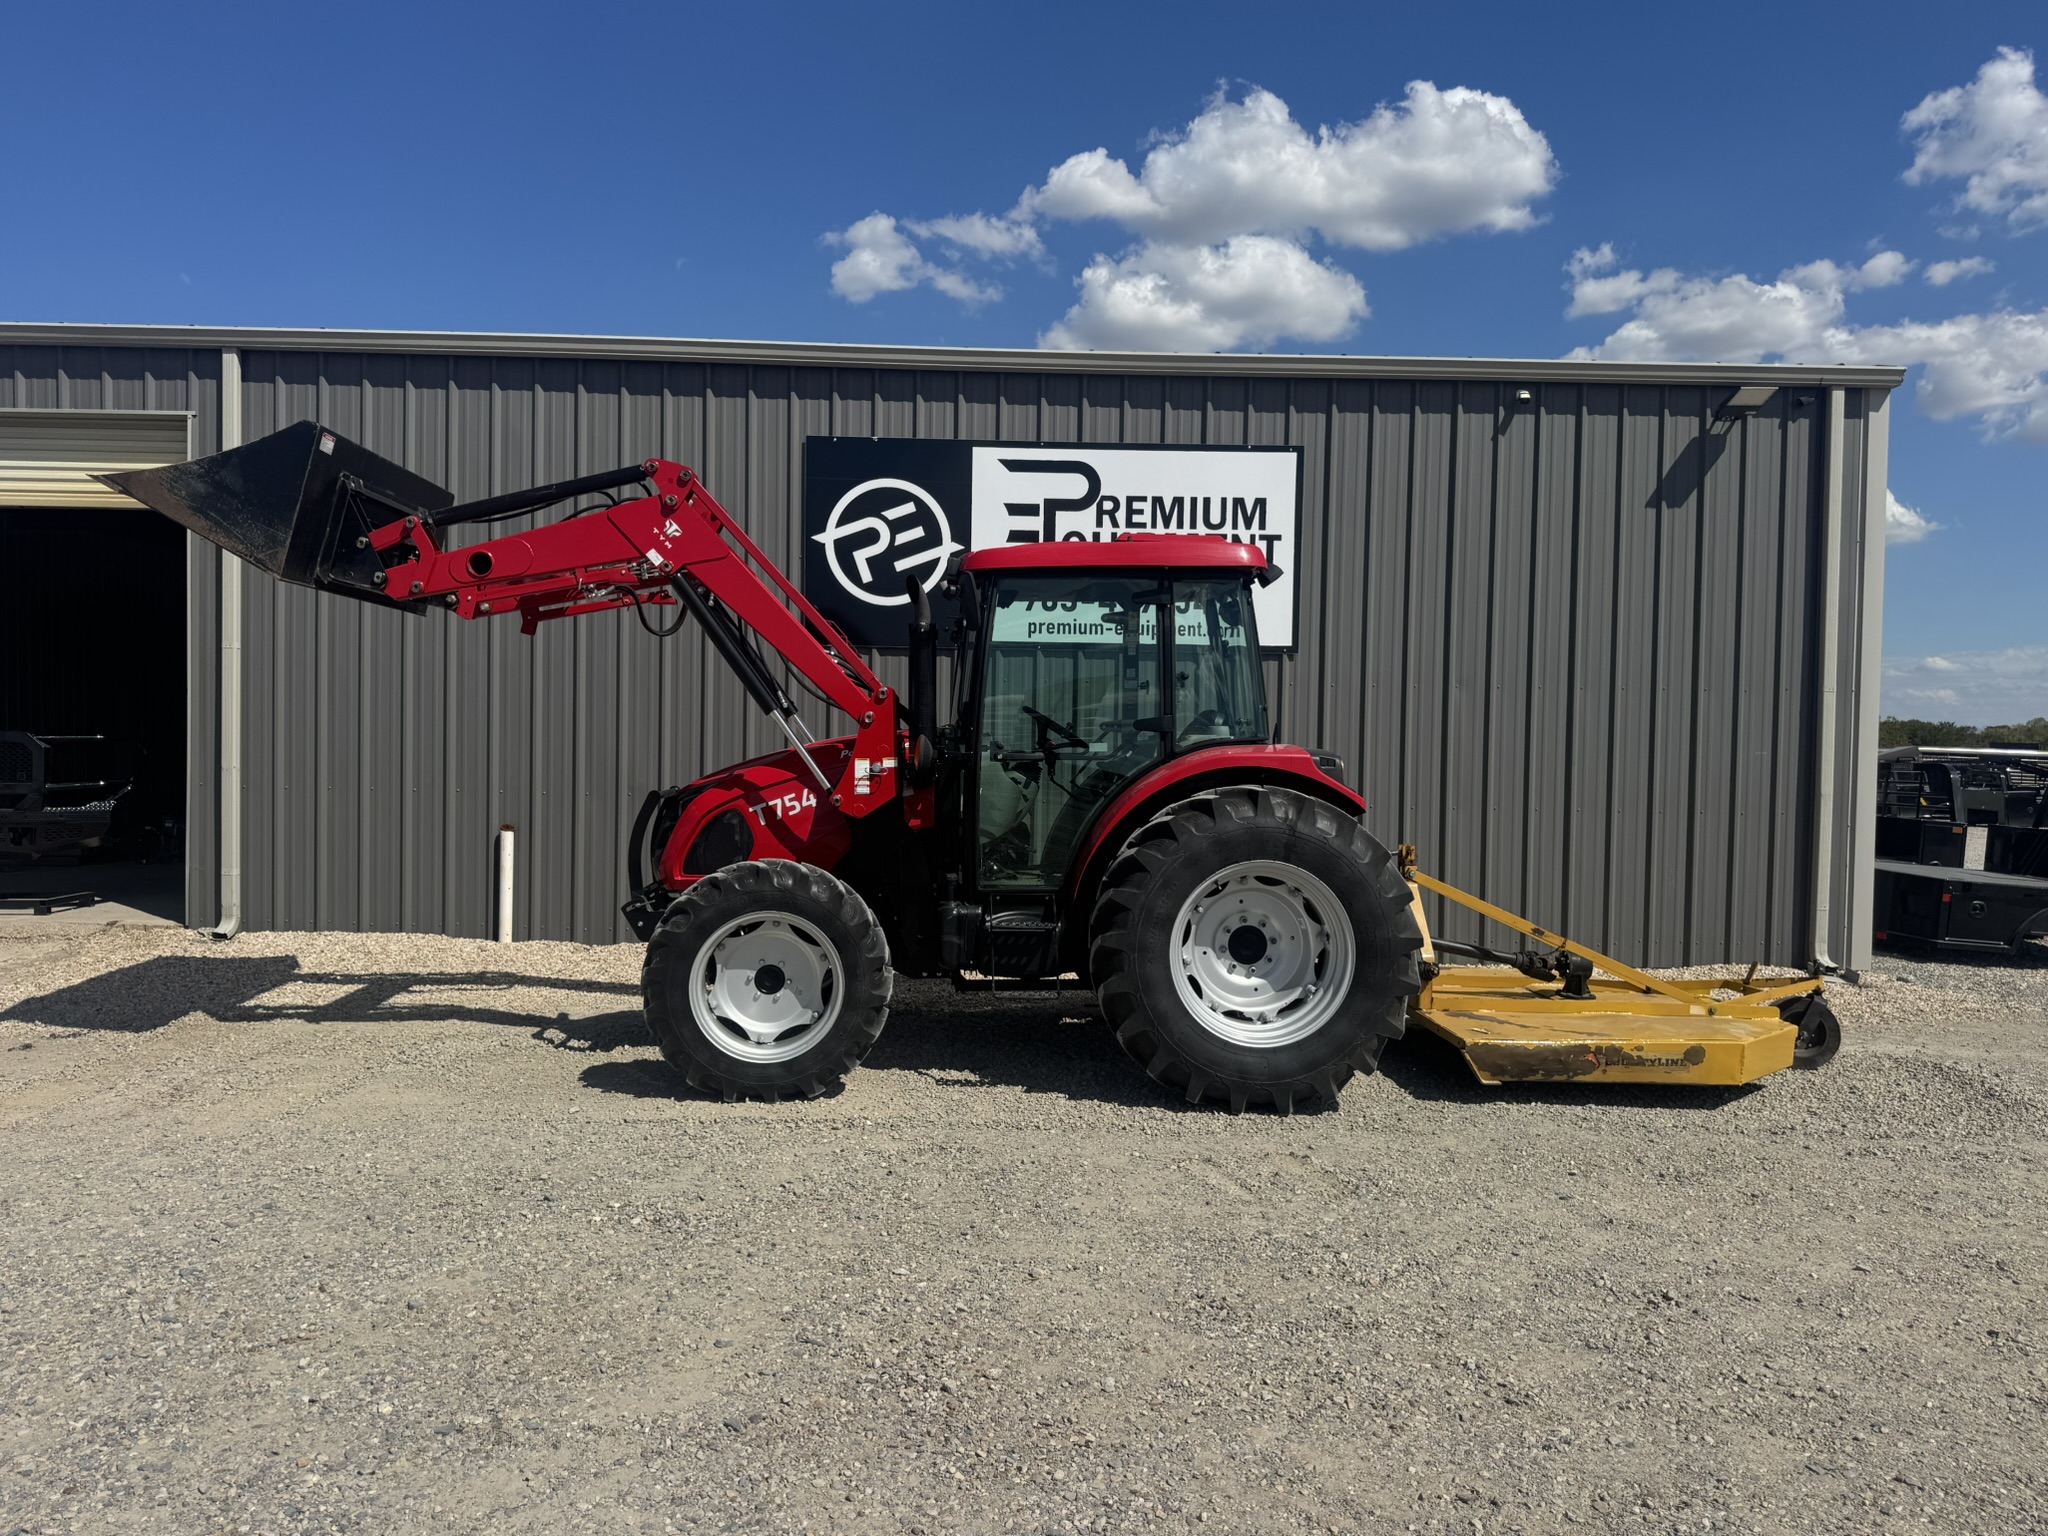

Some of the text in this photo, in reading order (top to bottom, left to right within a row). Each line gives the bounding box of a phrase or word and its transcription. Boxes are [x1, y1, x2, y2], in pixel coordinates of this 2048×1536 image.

[653, 527, 672, 549] TYM
[1027, 618, 1241, 638] premium-euipent.m
[748, 788, 817, 826] T754
